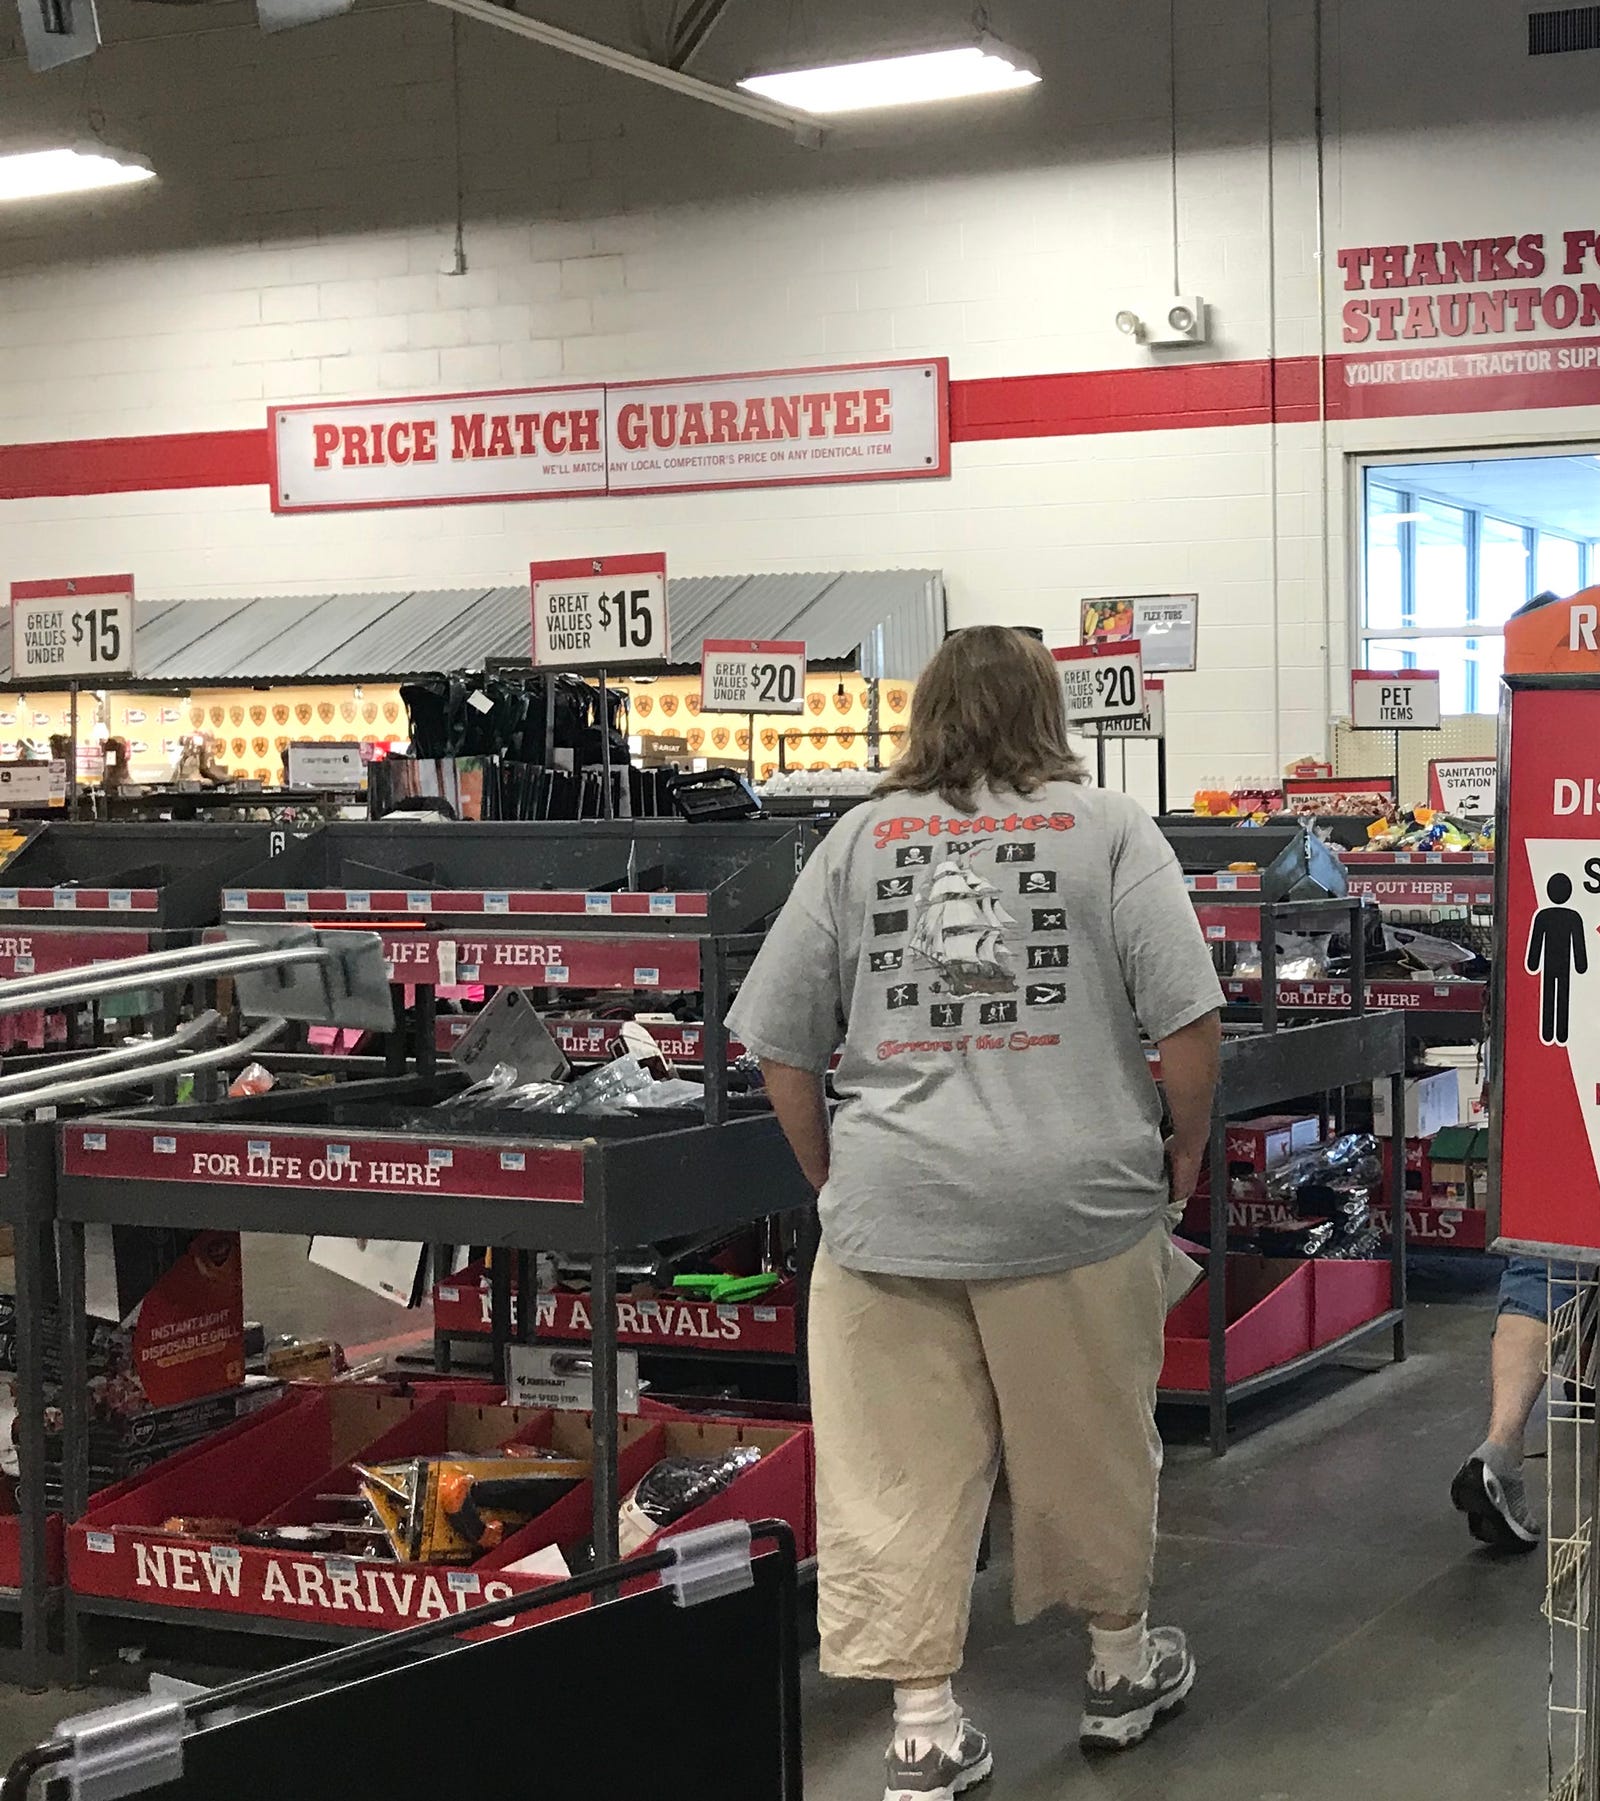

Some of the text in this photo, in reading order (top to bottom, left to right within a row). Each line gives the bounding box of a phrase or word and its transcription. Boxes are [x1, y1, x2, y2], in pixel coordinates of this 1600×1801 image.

[1338, 232, 1546, 291] THANKS
[1345, 363, 1395, 385] YOUR
[1400, 360, 1458, 381] LOCAL
[1465, 352, 1551, 376] TRACTOR
[313, 388, 891, 468] PRICE MATCH GUARANTEE
[542, 444, 892, 475] WE'LL MATCH ANY LOCAL COMPETITOR'S PRICE ON ANY IDENTICAL ITEM
[549, 595, 590, 614] GREAT
[27, 611, 63, 630] GREAT
[547, 612, 592, 632] VALUES
[598, 589, 651, 648] $15
[25, 629, 66, 647] VALUES
[72, 608, 120, 662] $15
[550, 631, 591, 650] UNDER
[27, 647, 64, 664] UNDER
[715, 663, 747, 676] GREAT
[1064, 670, 1091, 684] GREAT
[713, 675, 748, 689] VALUES
[751, 663, 795, 703] $20
[1095, 665, 1136, 708] $20
[713, 688, 746, 702] UNDER
[1380, 687, 1412, 707] PET
[1379, 707, 1413, 721] ITEMS
[1438, 766, 1497, 778] SANITATION
[1447, 778, 1491, 788] STATION
[873, 812, 1076, 849] Pirates
[1348, 881, 1453, 894] IFE OUT HERE
[494, 944, 562, 966] HERE
[1303, 992, 1420, 1007] LIFE OT HERE
[563, 1037, 600, 1051] LIFE
[877, 1031, 1061, 1061] Terrors of the Seas
[193, 1153, 441, 1187] FOR LIFE OUT HERE
[151, 1308, 230, 1341] INSTANT LIGHT
[569, 1300, 742, 1340] ARIVALS
[141, 1325, 240, 1361] DISPOSABLE GRILL
[132, 1543, 516, 1628] NEW ARRIVALS
